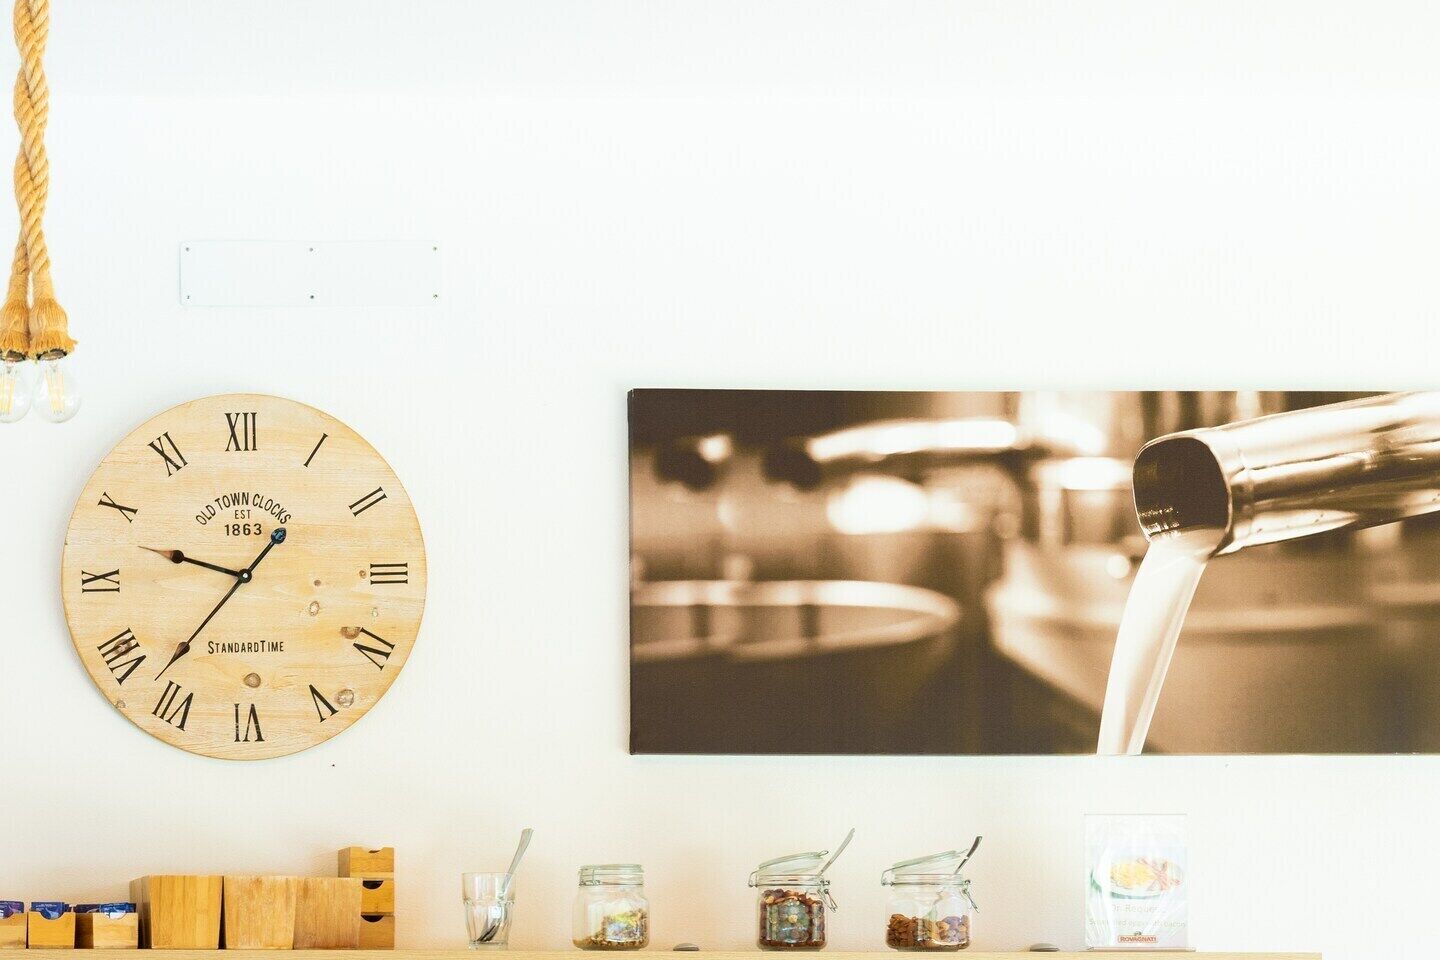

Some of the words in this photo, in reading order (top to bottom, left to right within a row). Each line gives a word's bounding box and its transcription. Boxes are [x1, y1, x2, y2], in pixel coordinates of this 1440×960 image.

[224, 412, 258, 452] XII
[147, 431, 188, 477] XI
[303, 433, 328, 468] I
[97, 491, 139, 523] X
[195, 504, 216, 525] OLD
[214, 492, 250, 511] TOWN
[252, 493, 292, 524] CLOCKS
[234, 509, 251, 519] EST
[348, 486, 388, 517] II
[224, 523, 262, 536] 1863
[81, 567, 120, 593] IX
[369, 562, 408, 585] III
[96, 627, 147, 686] VIII
[352, 627, 396, 671] IV
[151, 680, 194, 731] VII
[308, 684, 339, 723] V
[234, 703, 265, 742] VI
